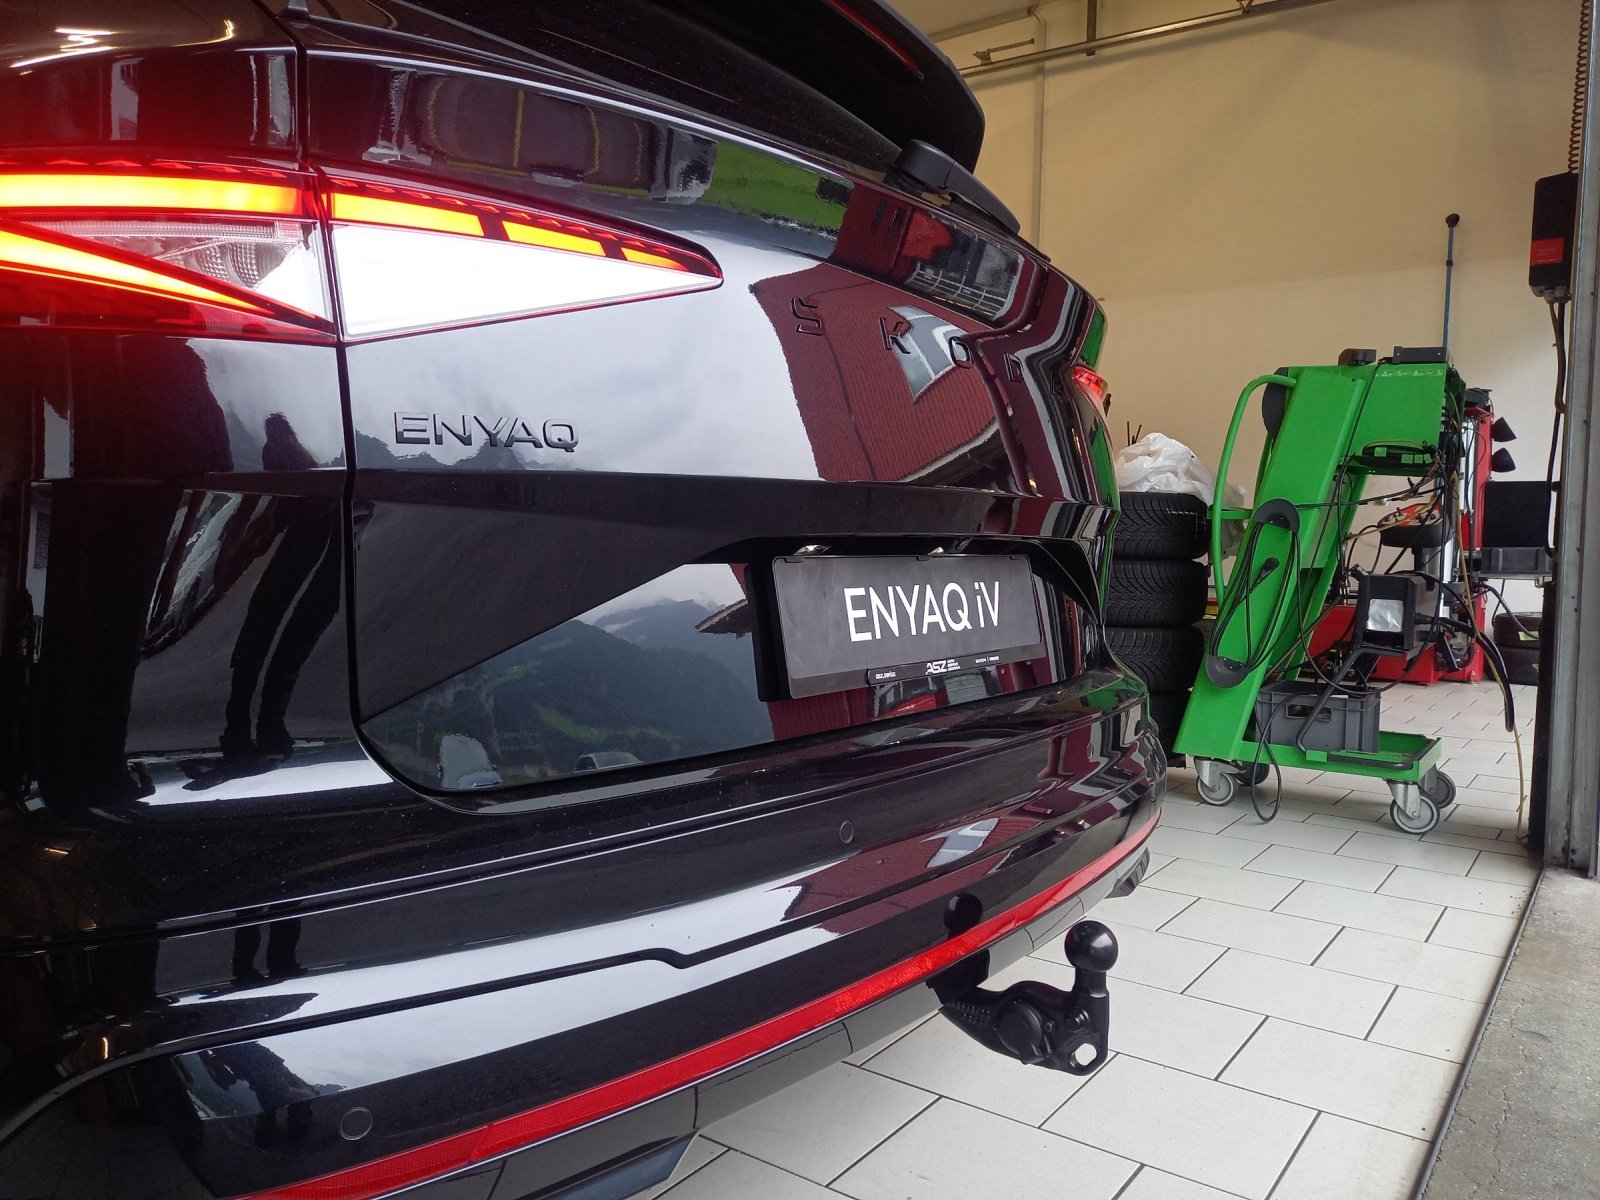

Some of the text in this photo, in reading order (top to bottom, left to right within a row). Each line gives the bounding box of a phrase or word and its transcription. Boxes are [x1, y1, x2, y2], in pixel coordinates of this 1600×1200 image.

[394, 411, 580, 452] ENYAQ
[843, 581, 1000, 642] ENYAQ iV
[925, 660, 948, 676] ASZ
